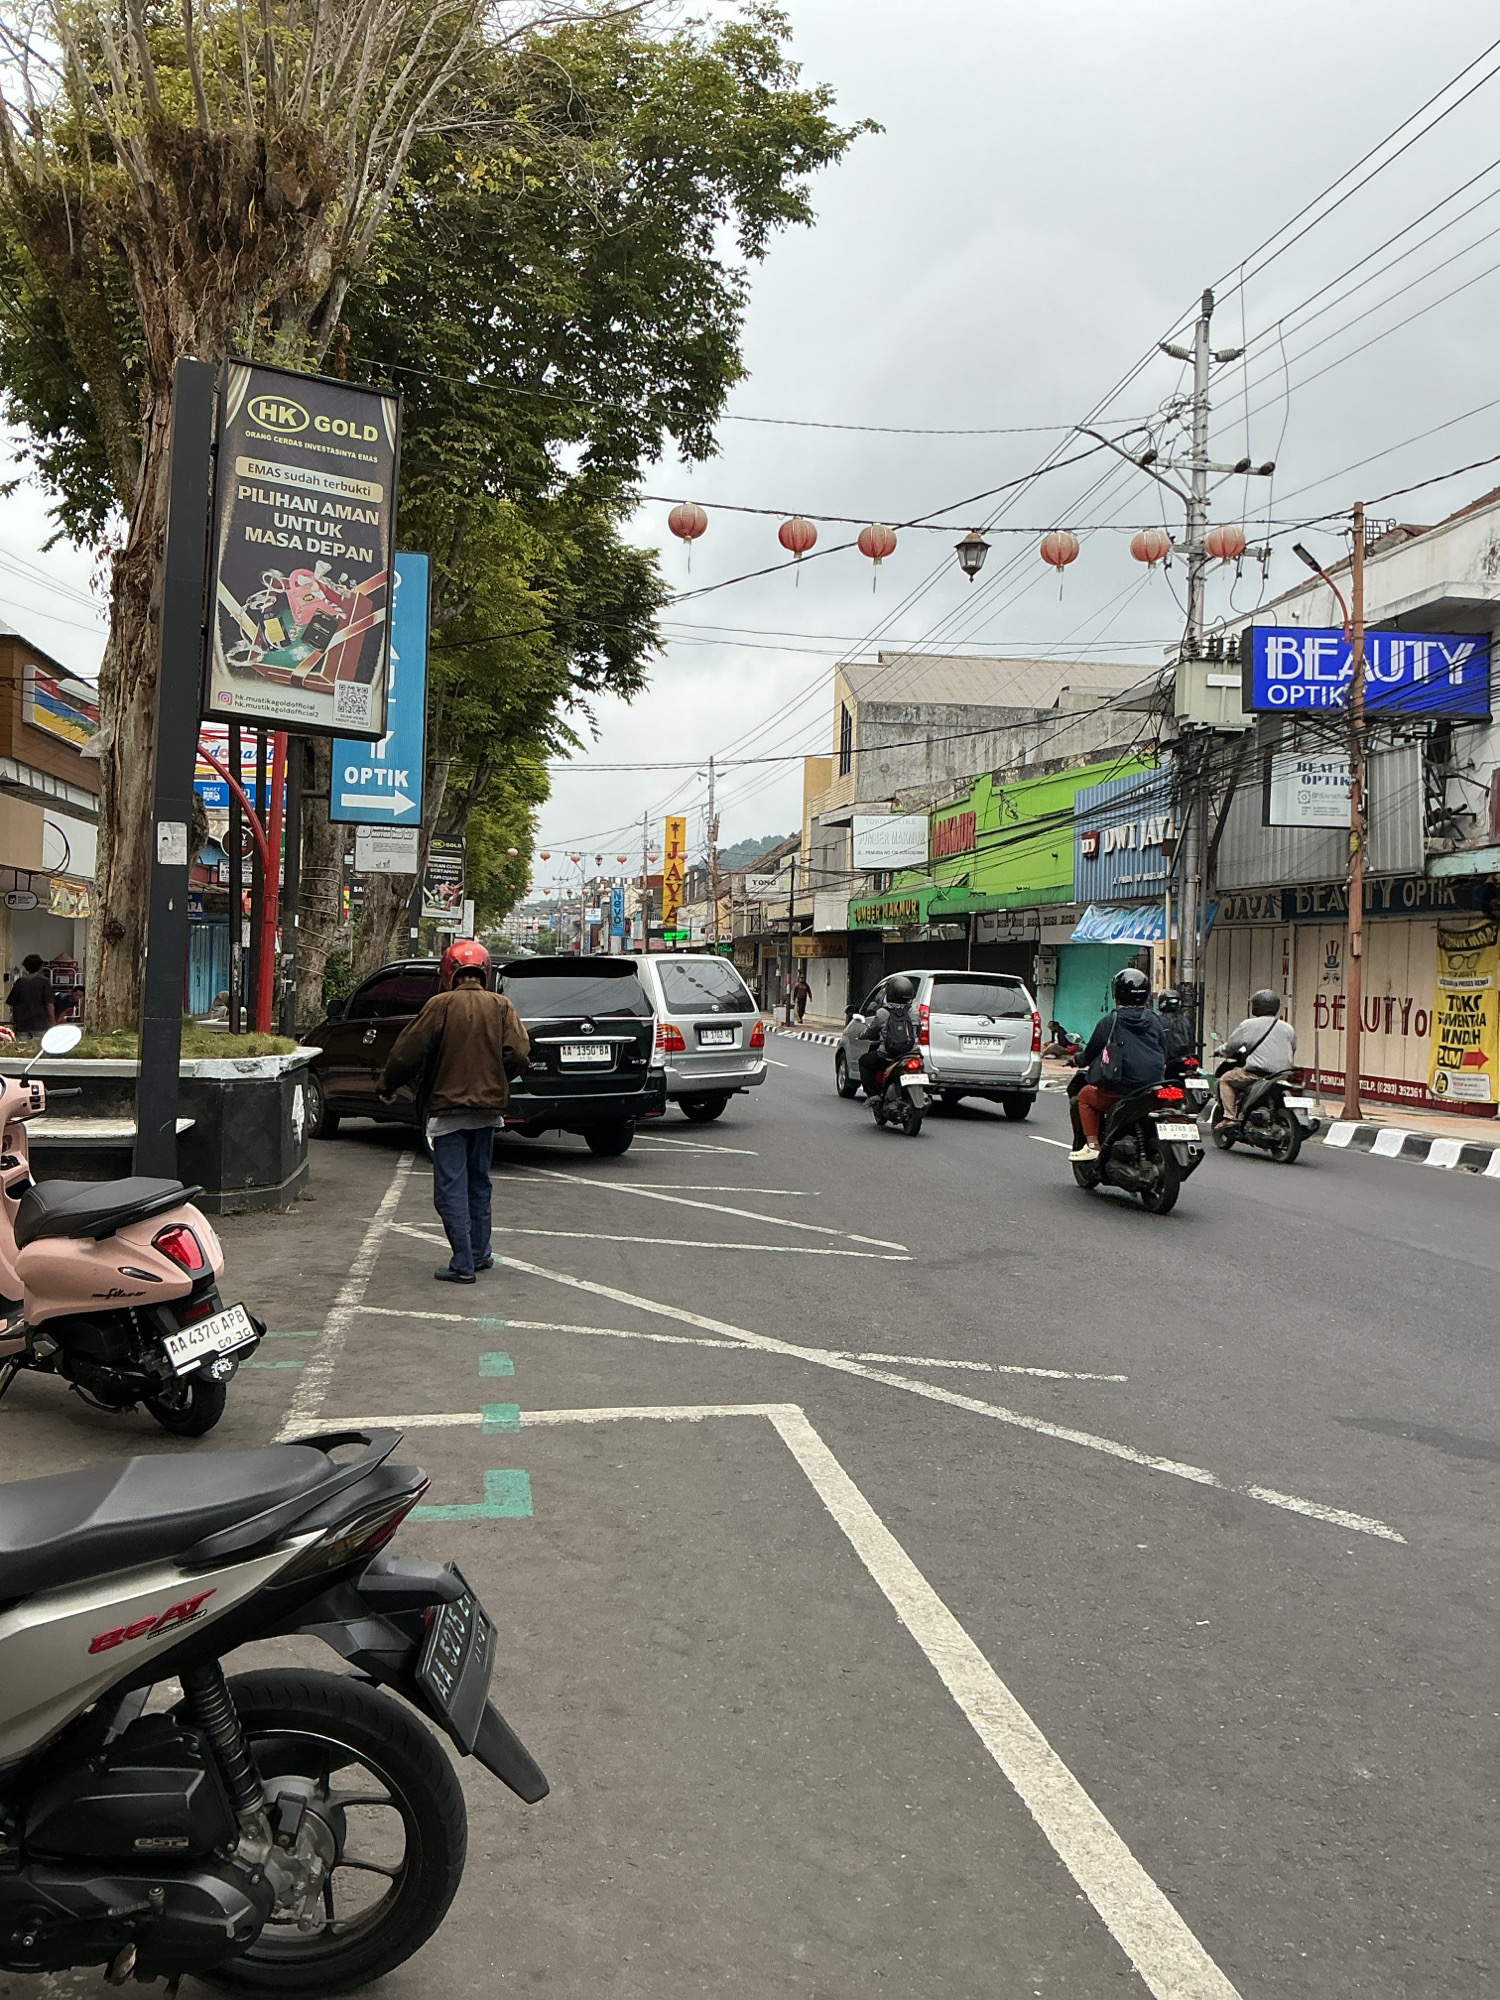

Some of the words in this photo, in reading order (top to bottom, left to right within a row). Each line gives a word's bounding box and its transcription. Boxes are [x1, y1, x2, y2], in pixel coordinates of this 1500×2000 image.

[260, 401, 298, 427] HK
[314, 415, 379, 442] GOLD
[245, 430, 272, 441] ORANG
[273, 435, 303, 448] CERDAS
[304, 442, 357, 460] INVESTASINYA
[357, 453, 379, 464] EMAS
[247, 462, 281, 478] EMAS
[323, 478, 371, 497] terbukti
[237, 484, 318, 514] PILIHAN
[321, 502, 380, 526] AMAN
[273, 512, 343, 539] UNTUK
[245, 526, 304, 551] MASA
[306, 541, 374, 563] DEPAN
[1265, 636, 1476, 685] BEAUTY
[234, 692, 316, 710] hk.mustikagoldofficial
[234, 701, 320, 719] hk.mustikagoldofficial2
[1267, 684, 1345, 706] OPTIK
[344, 766, 410, 788] OPTIK
[1297, 762, 1350, 774] BEAUT
[1104, 822, 1138, 853] DWI
[1223, 894, 1277, 920] JAYA
[1295, 879, 1395, 913] BEATY
[1402, 877, 1457, 907] OPTIK
[1313, 993, 1415, 1036] BEUTY
[562, 1046, 572, 1056] AA
[576, 1045, 596, 1056] 1350
[599, 1045, 609, 1055] BA
[170, 1336, 188, 1356] AA
[189, 1321, 220, 1345] 4370
[220, 1309, 245, 1331] APB
[430, 1657, 454, 1702] AA
